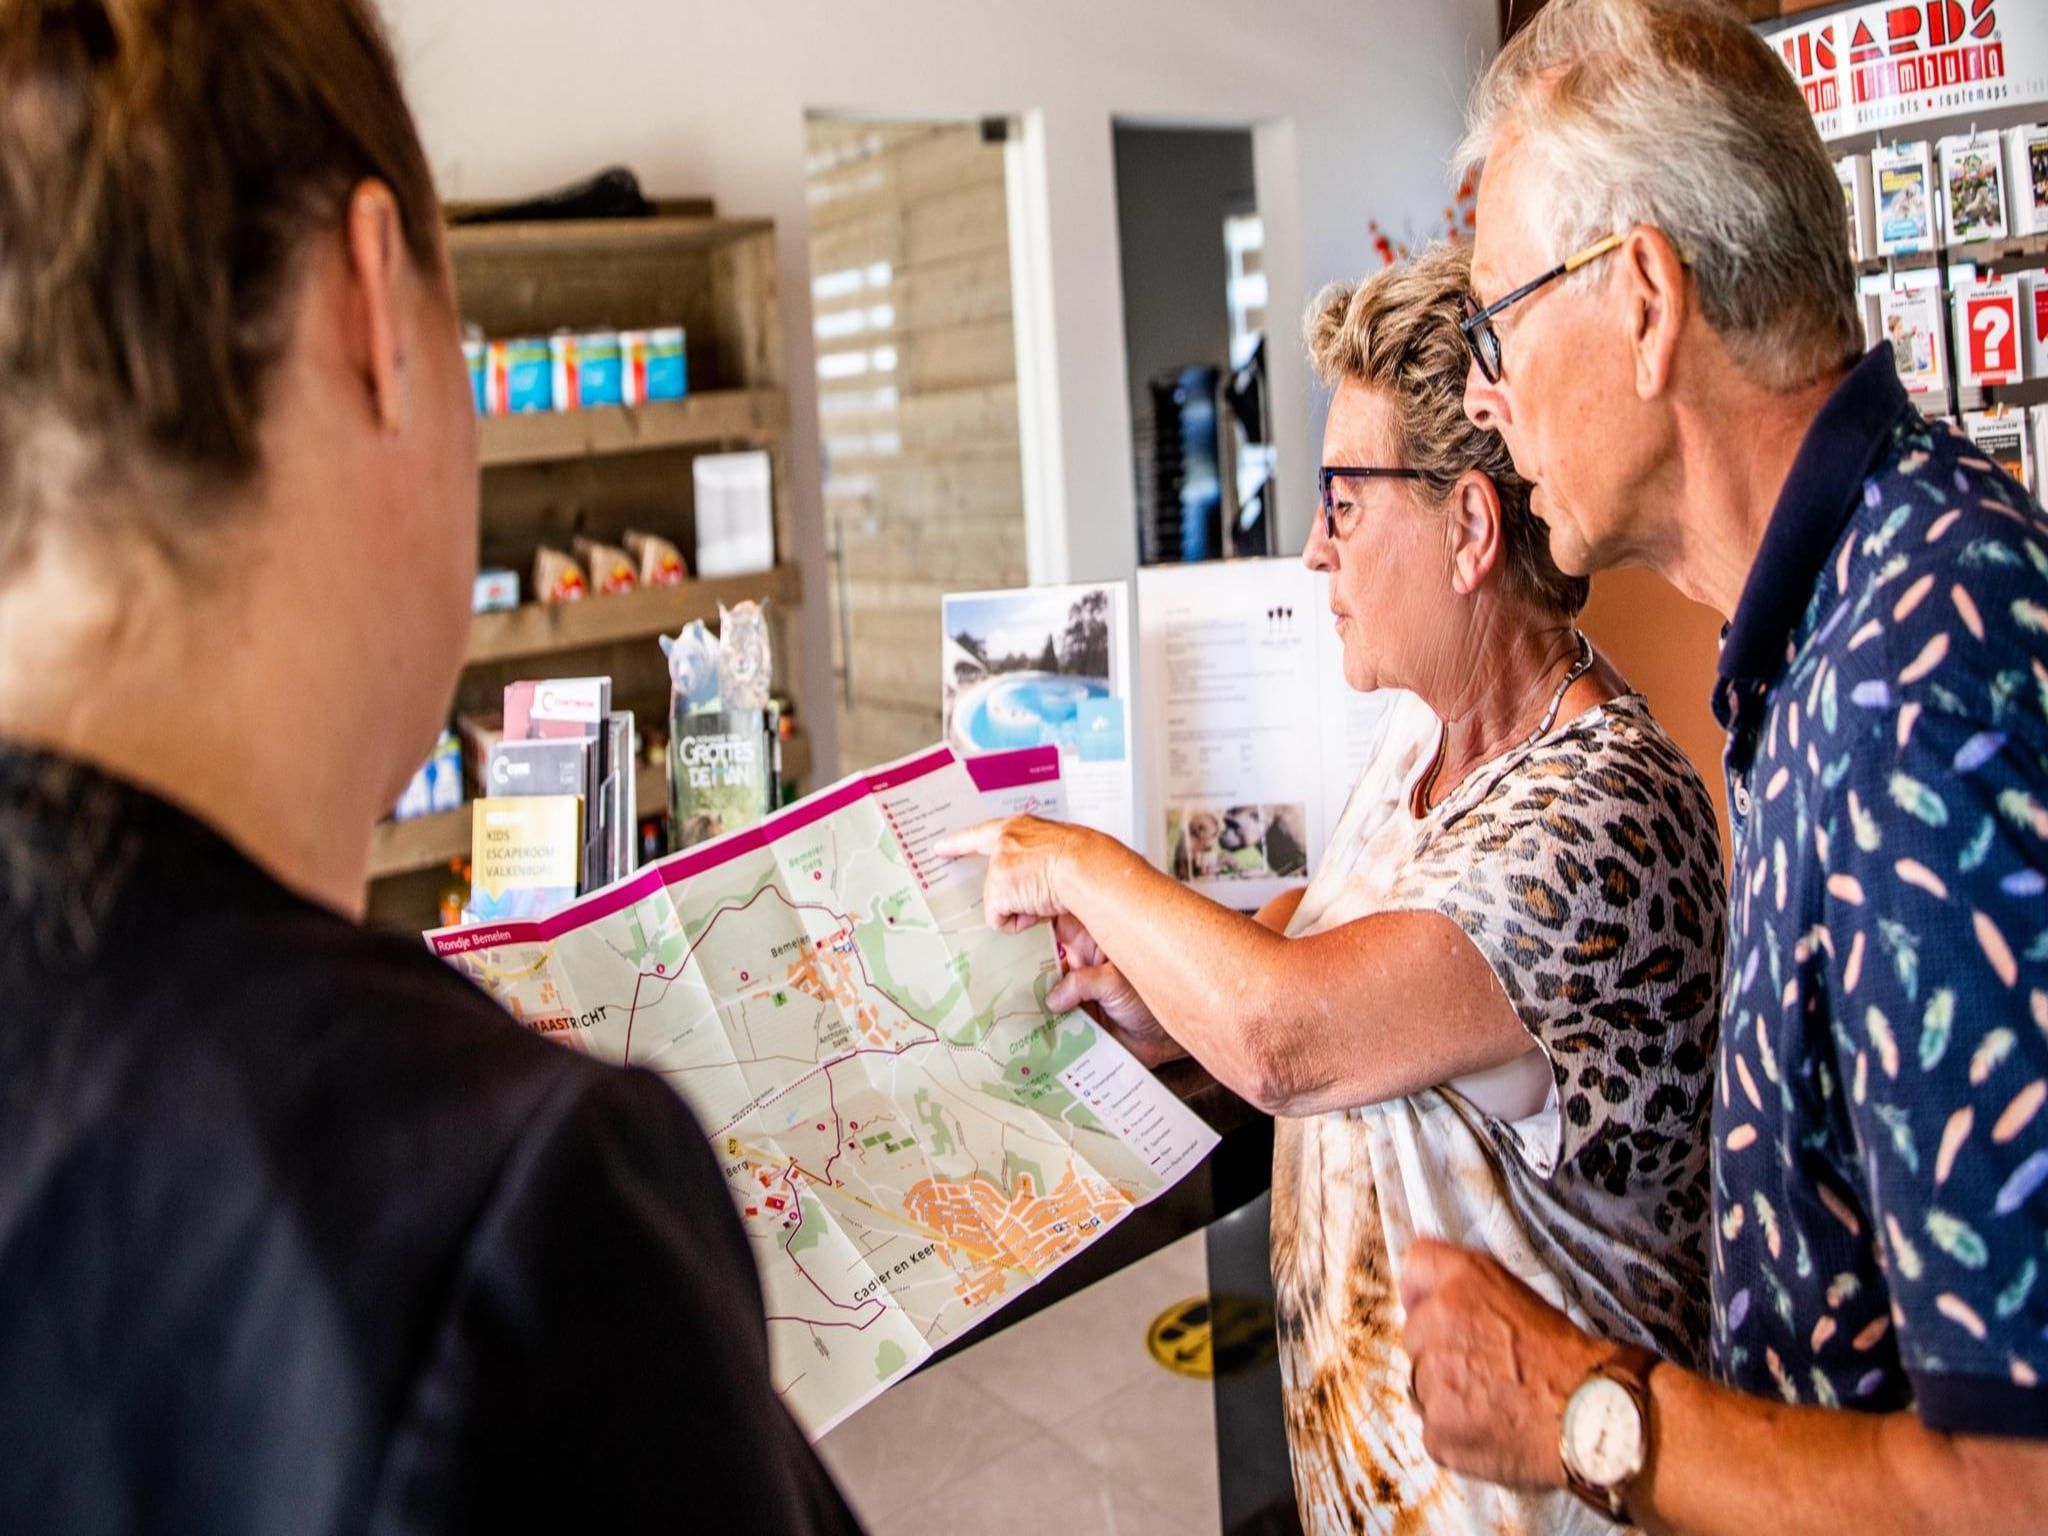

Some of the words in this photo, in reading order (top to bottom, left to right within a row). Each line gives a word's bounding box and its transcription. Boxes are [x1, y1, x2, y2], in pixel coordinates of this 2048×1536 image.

[1939, 86, 2008, 108] routemaps
[486, 829, 510, 842] KIDS
[437, 937, 470, 952] Rondje
[472, 930, 512, 945] Bemelen
[528, 1006, 608, 1034] MAASTRICHT
[725, 1160, 749, 1178] Berg
[853, 1270, 892, 1302] Cadier
[893, 1260, 910, 1275] en
[909, 1243, 937, 1266] Keer
